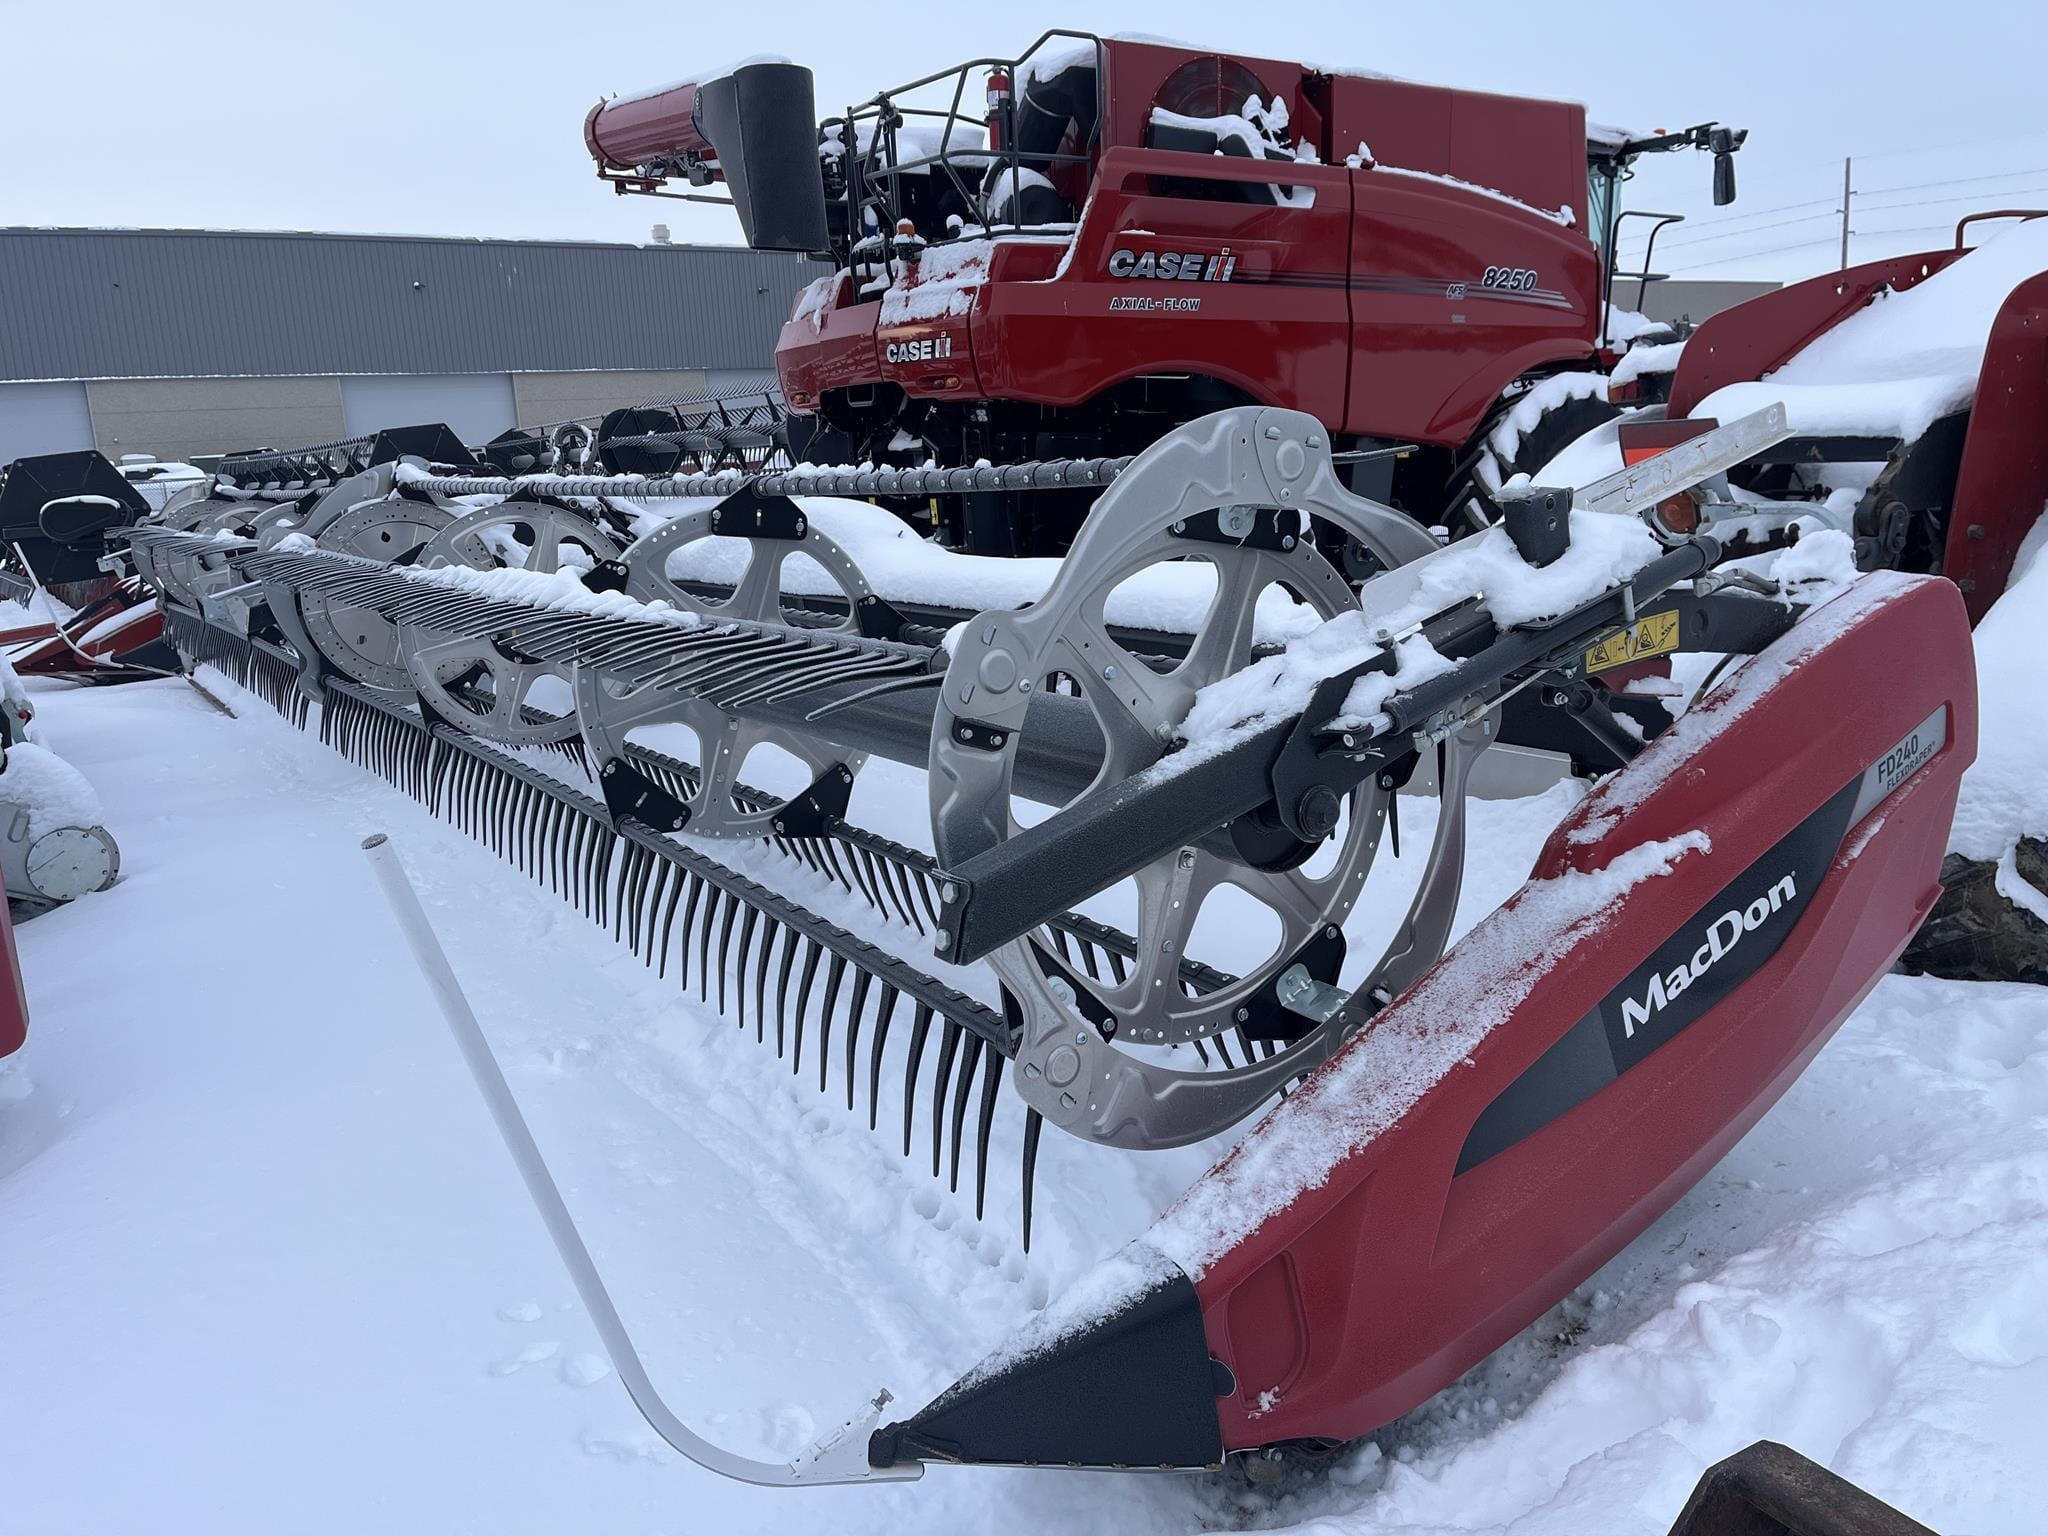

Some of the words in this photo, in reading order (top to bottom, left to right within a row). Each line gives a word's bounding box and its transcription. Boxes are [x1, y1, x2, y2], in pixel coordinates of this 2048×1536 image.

[1109, 249, 1205, 280] CASE
[1482, 266, 1537, 293] 8250
[1109, 297, 1201, 312] AXIAL-FLOW
[886, 339, 933, 363] CASE
[1877, 734, 1918, 784] FD240
[1621, 875, 1796, 1039] MacDon
